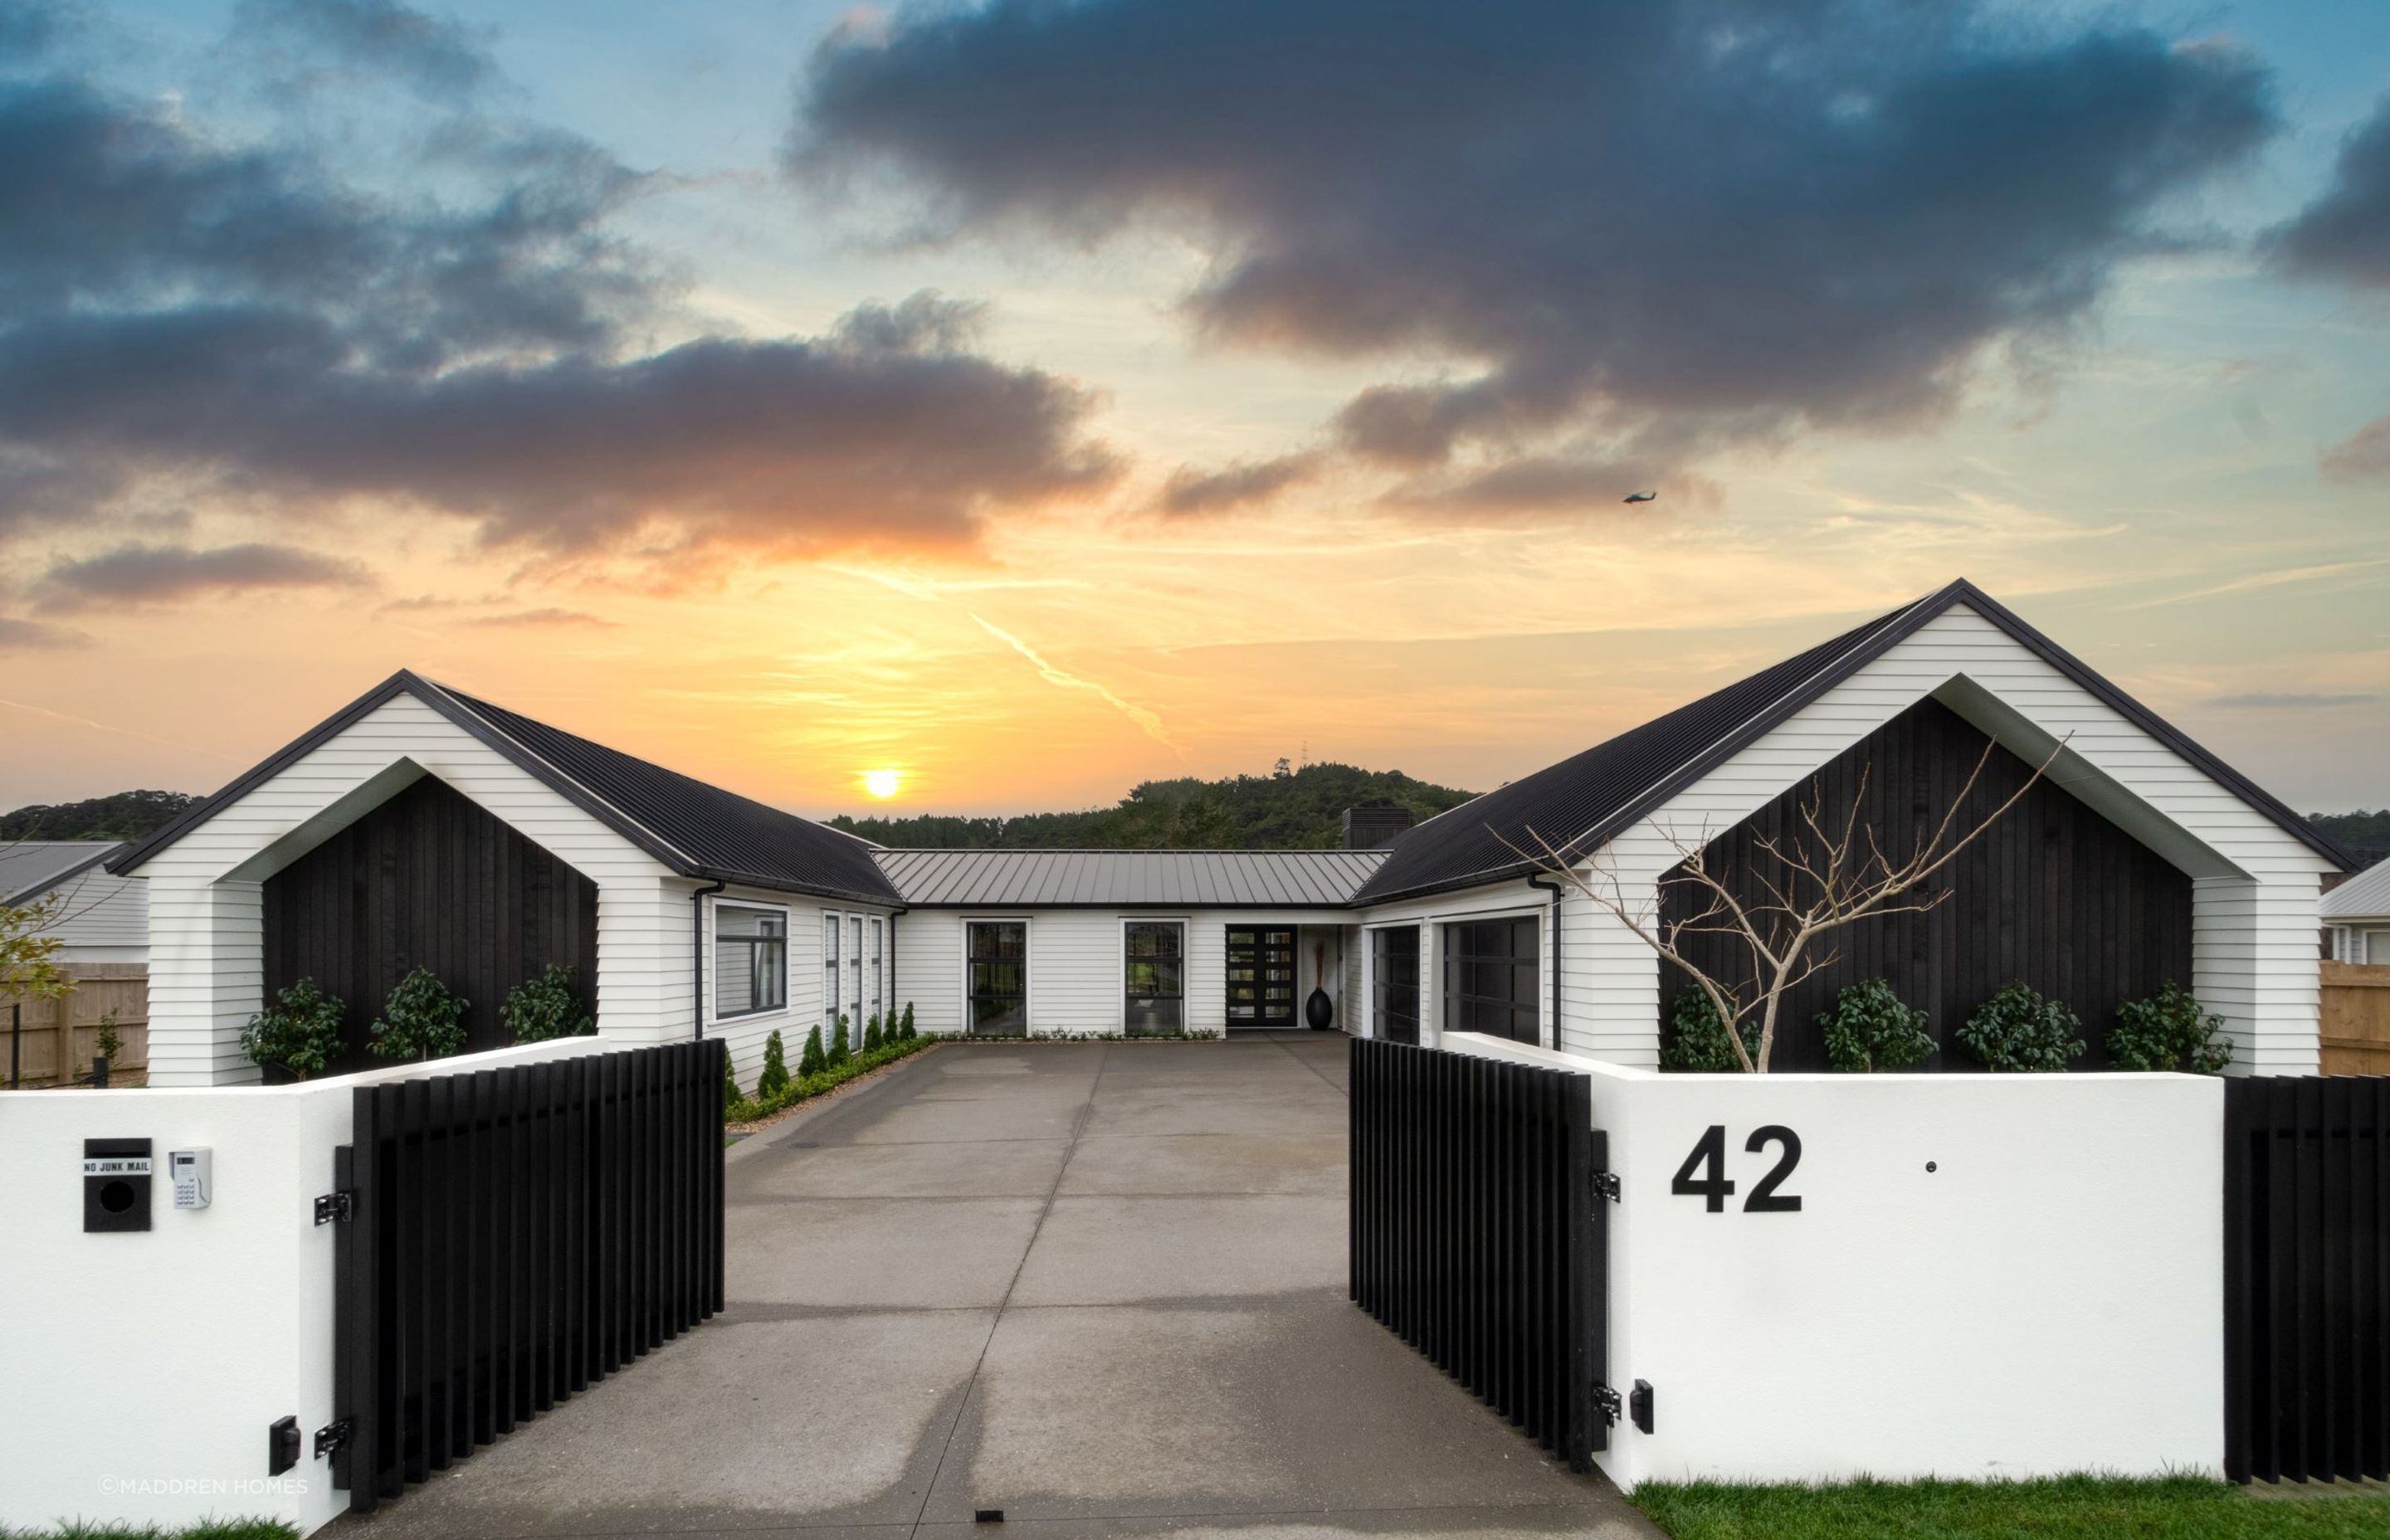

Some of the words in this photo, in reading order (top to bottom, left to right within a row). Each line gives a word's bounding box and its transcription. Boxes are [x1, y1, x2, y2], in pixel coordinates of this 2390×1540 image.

[84, 1162, 96, 1172] NO
[100, 1162, 124, 1172] JUNK
[127, 1162, 149, 1171] MAIL
[1671, 1124, 1802, 1212] 42
